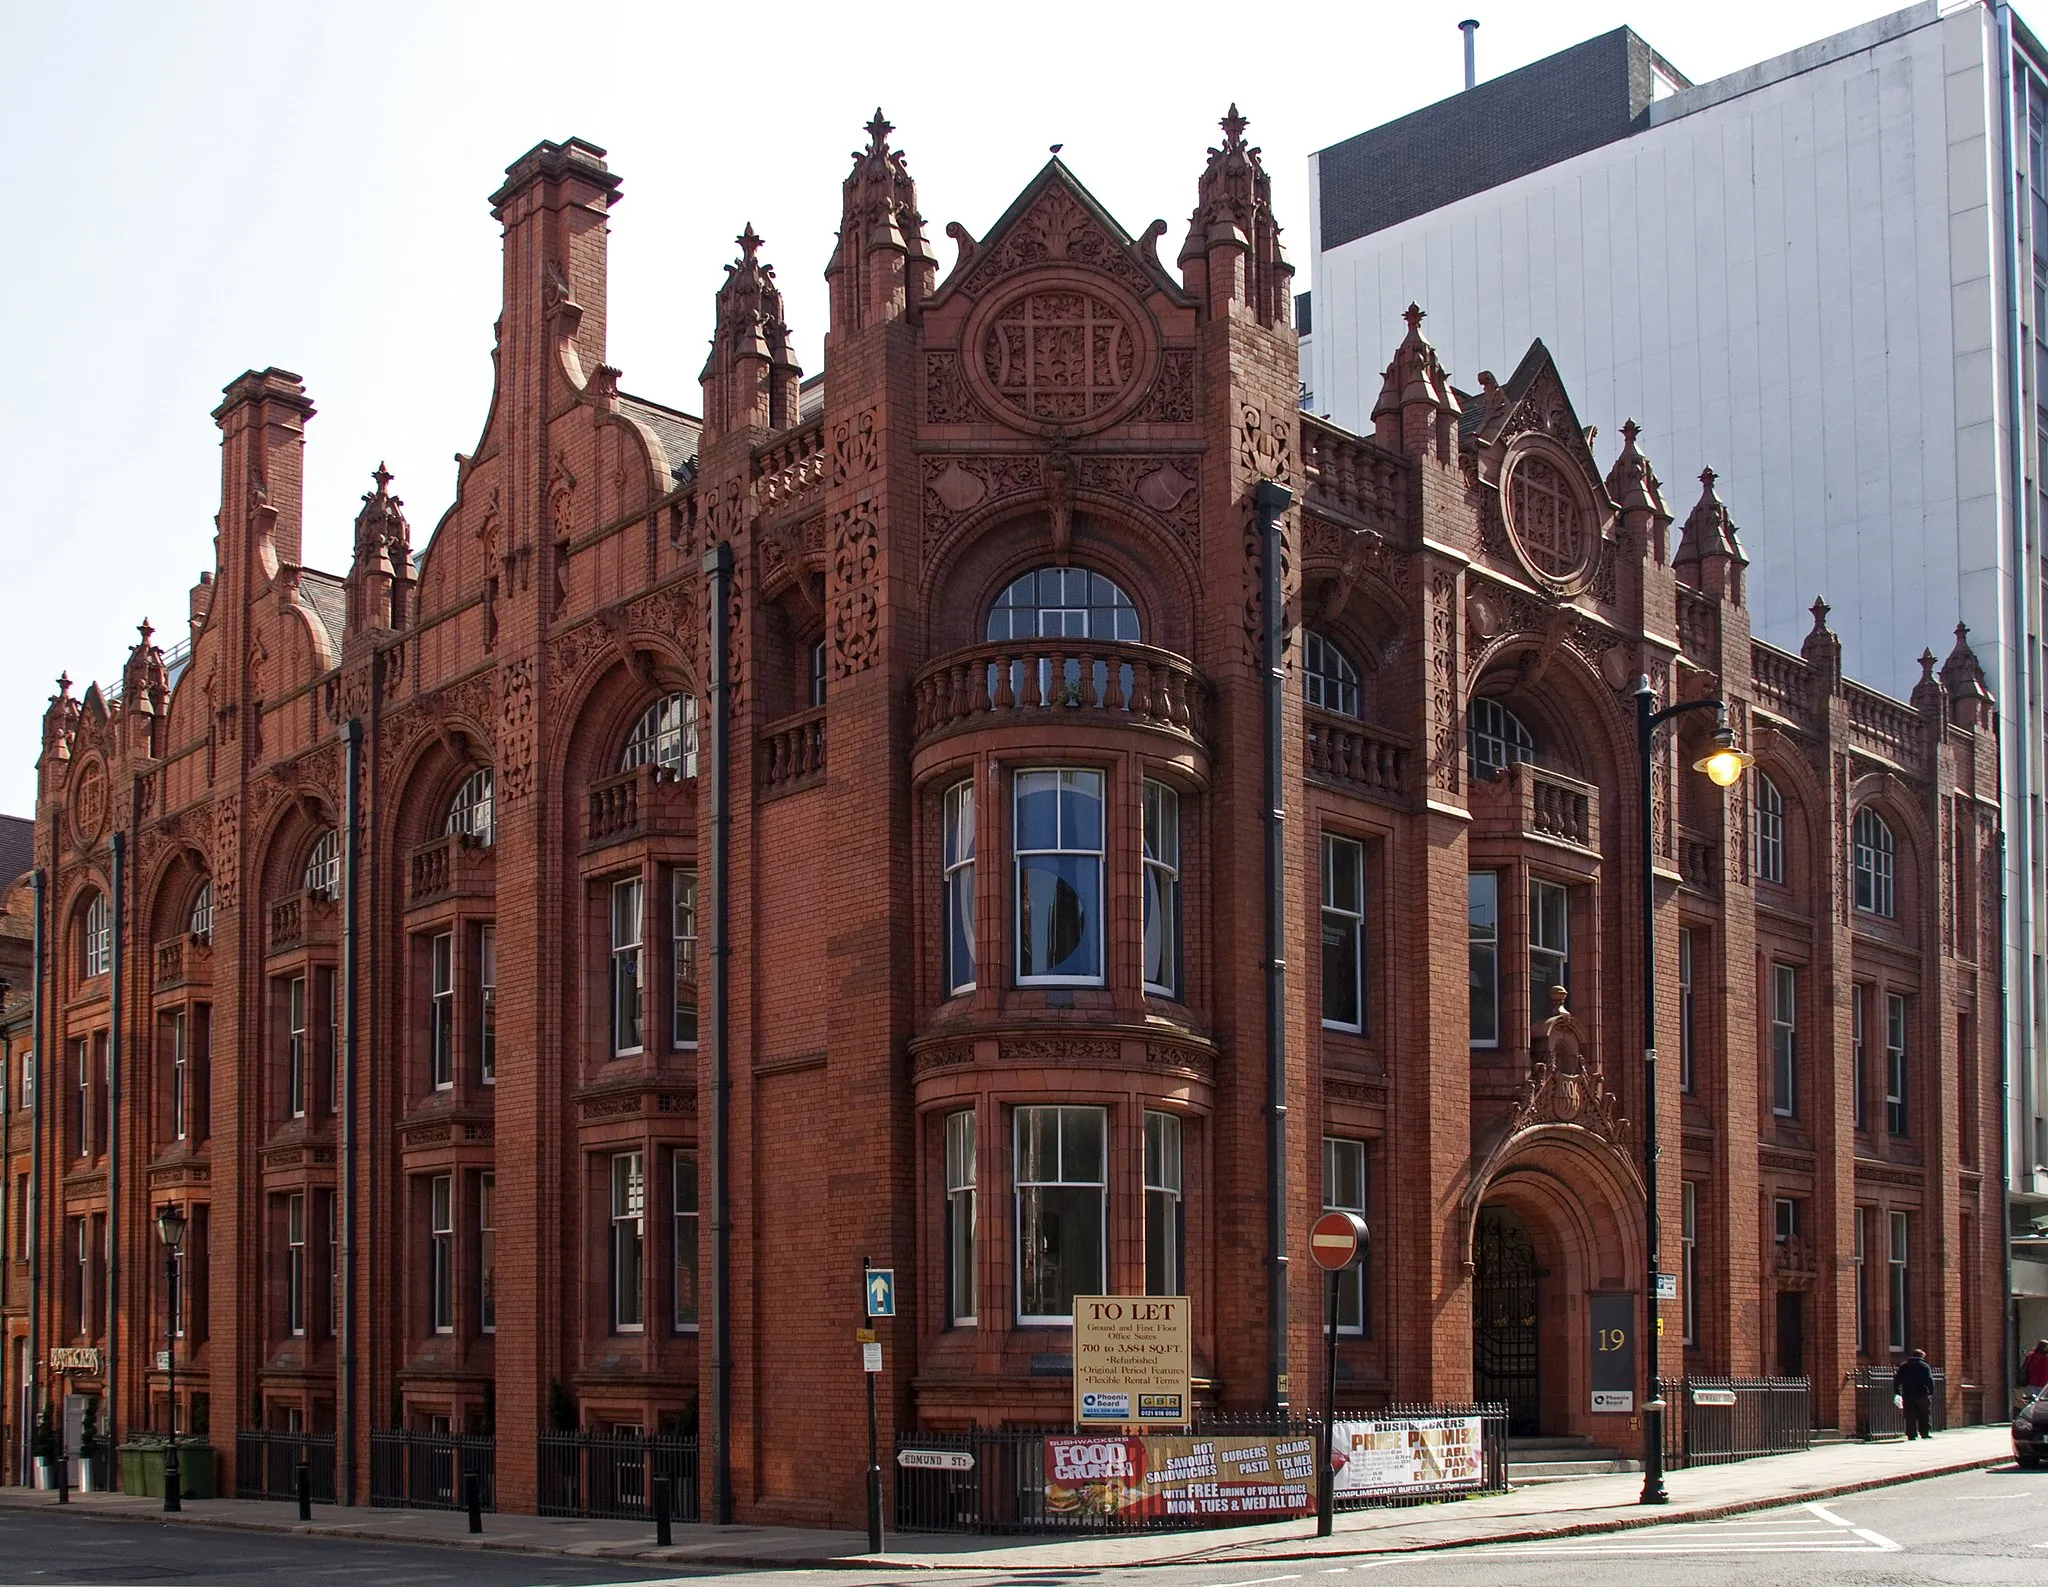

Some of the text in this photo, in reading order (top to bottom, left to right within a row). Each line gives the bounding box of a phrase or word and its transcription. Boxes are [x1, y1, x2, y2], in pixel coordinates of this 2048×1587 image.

[1089, 1303, 1176, 1320] TO LET
[1087, 1324, 1177, 1332] Ground and First Floor
[1134, 1332, 1157, 1340] Suites
[1598, 1328, 1625, 1351] 19
[1082, 1344, 1100, 1352] 700
[1118, 1344, 1145, 1353] 3,884
[1149, 1344, 1183, 1354] SQ.FT.
[1121, 1366, 1147, 1375] Period
[1151, 1367, 1185, 1375] Features
[1124, 1376, 1151, 1385] Rental
[1154, 1376, 1180, 1385] Terms
[1049, 1436, 1129, 1446] BUSHWACKERS
[1192, 1442, 1214, 1455] HOT
[1275, 1440, 1310, 1456] SALADS
[1351, 1431, 1402, 1452] PRICE
[904, 1454, 942, 1466] EDMUND
[1054, 1443, 1128, 1466] FOOD
[1221, 1446, 1268, 1463] BURGERS
[1413, 1446, 1472, 1460] AVILABLE
[1166, 1453, 1215, 1470] SAVOURY
[1239, 1460, 1270, 1475] PASTA
[1275, 1454, 1313, 1471] TEX MEX
[1444, 1456, 1466, 1468] DAY
[1054, 1461, 1134, 1480] CRUNCH
[1146, 1465, 1218, 1484] SANDWICHES
[1283, 1465, 1313, 1480] GRILLS
[1451, 1466, 1473, 1478] DAY
[1162, 1483, 1307, 1499] WITH FREE DRINK OF YOUR CHOICE
[1398, 1484, 1424, 1494] BUFFET
[1167, 1494, 1308, 1514] MON, TUES & WED ALL DAY
